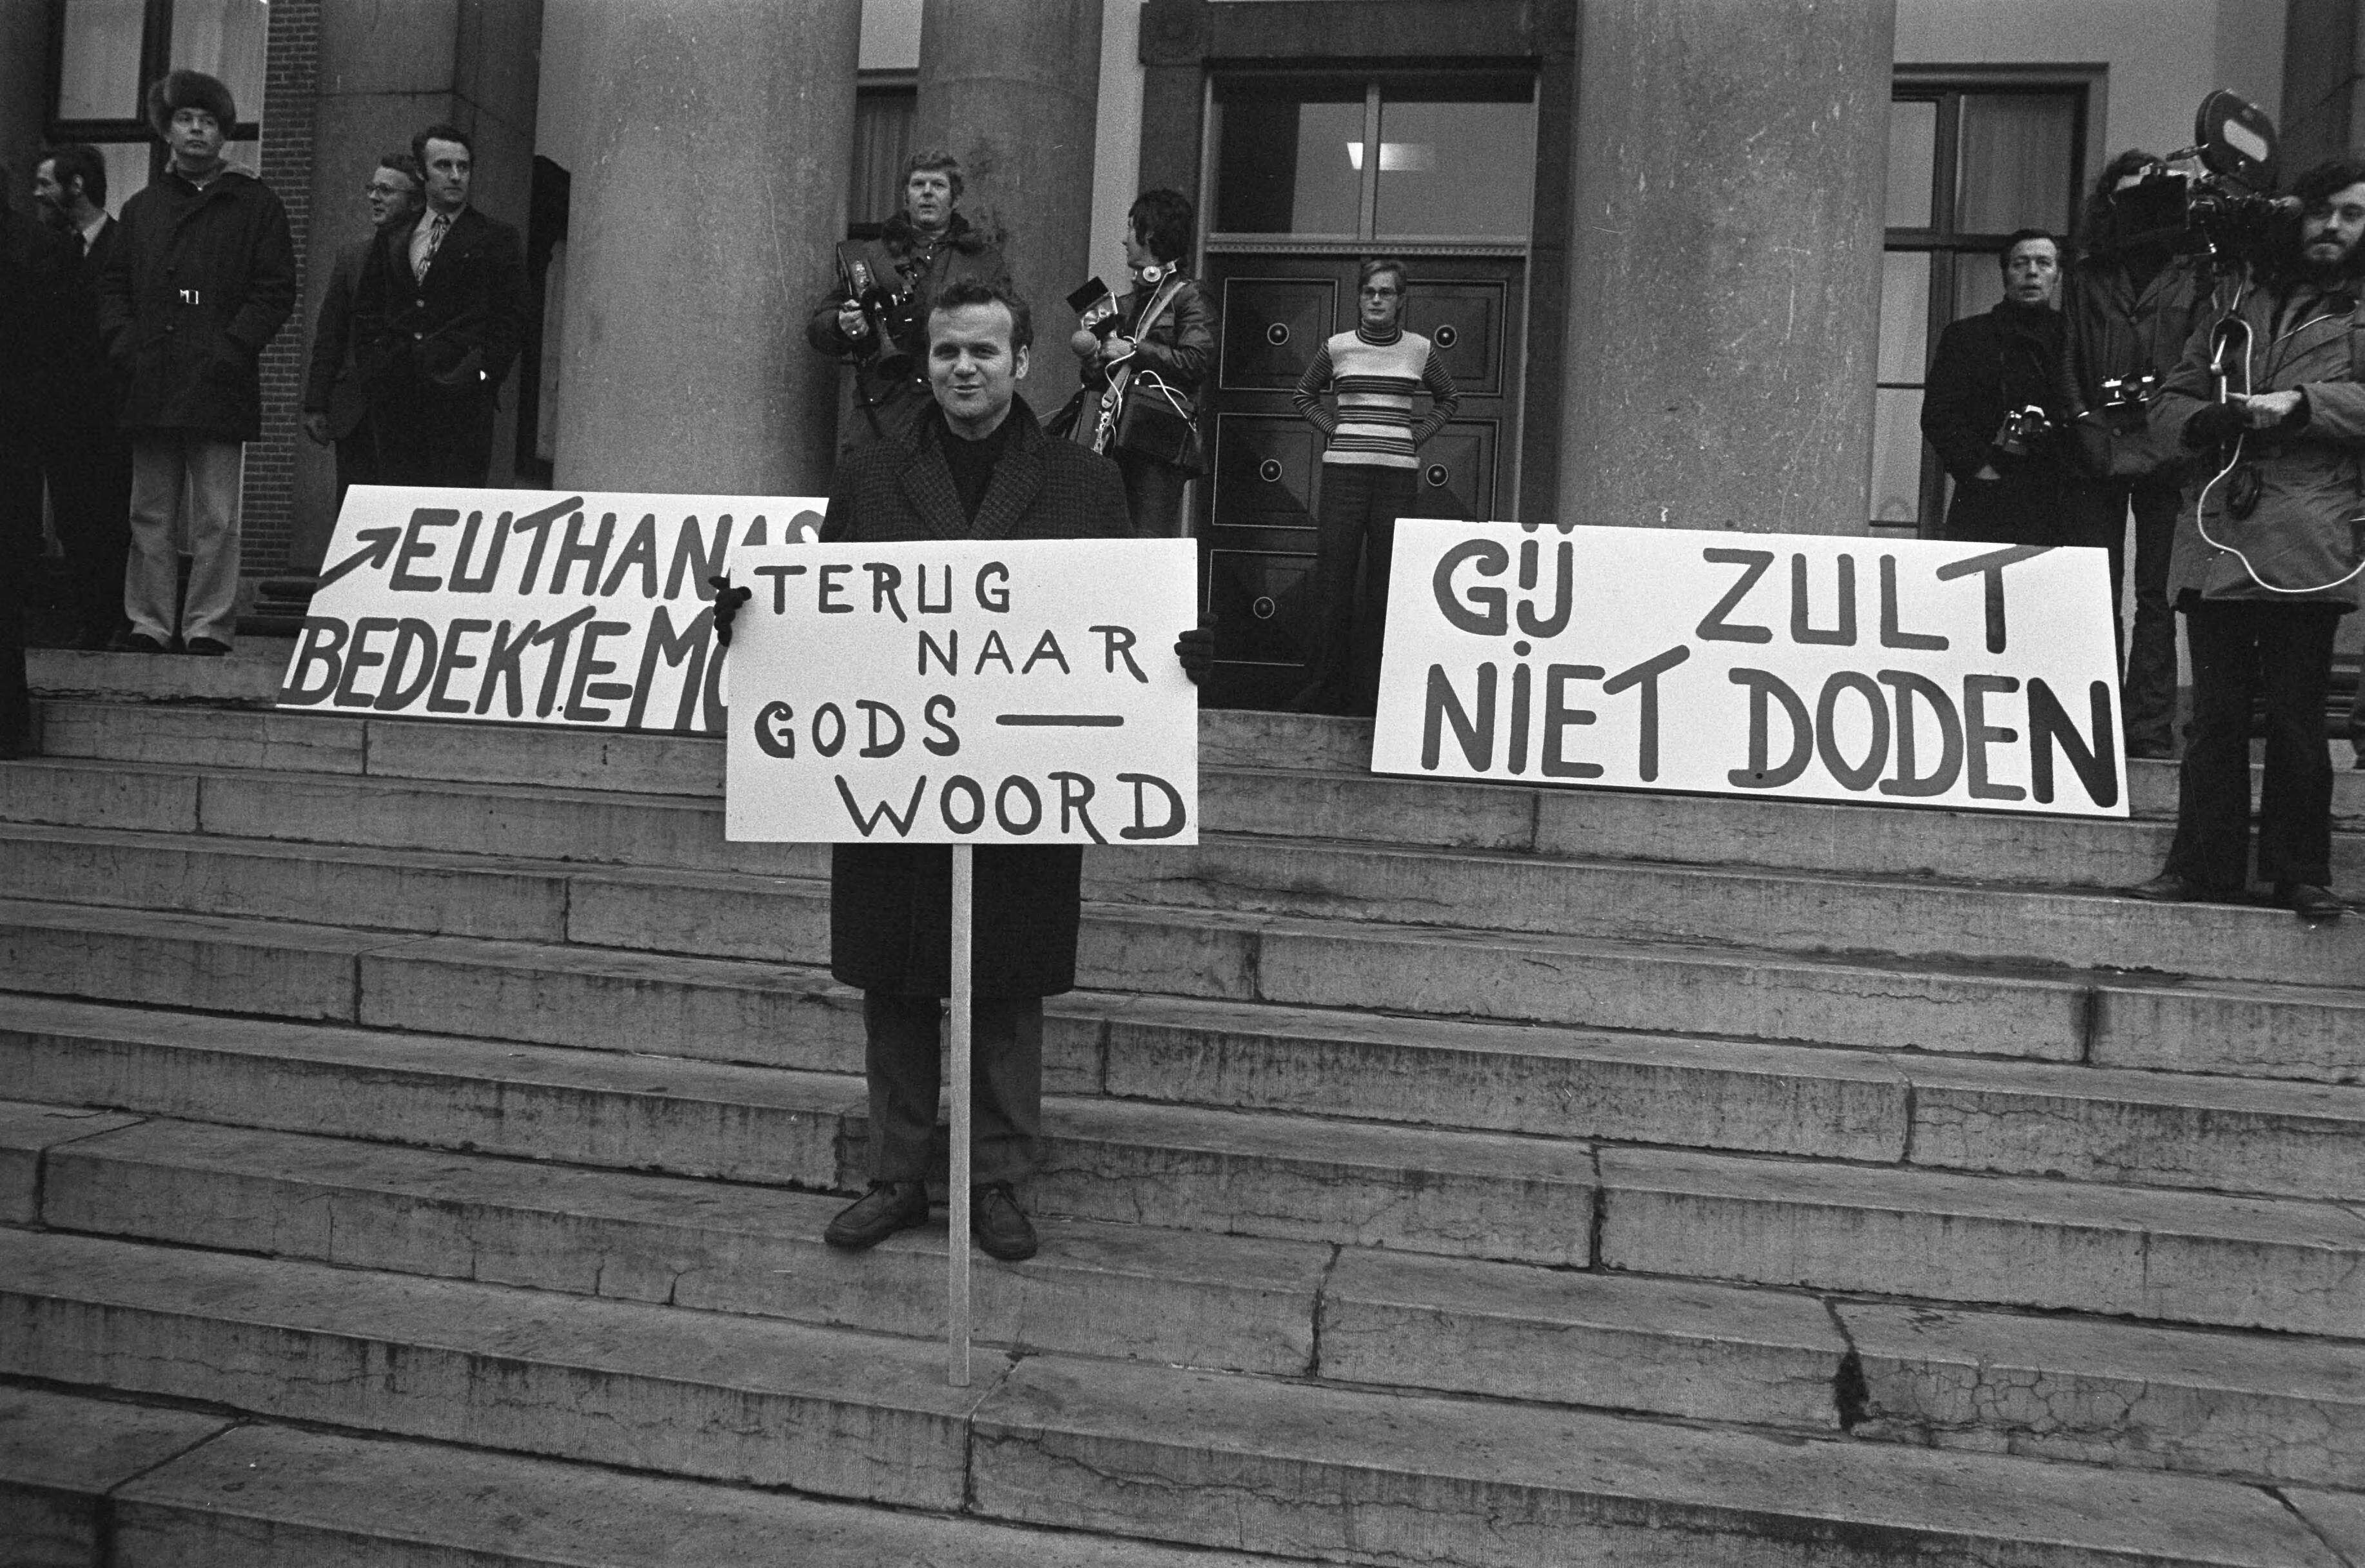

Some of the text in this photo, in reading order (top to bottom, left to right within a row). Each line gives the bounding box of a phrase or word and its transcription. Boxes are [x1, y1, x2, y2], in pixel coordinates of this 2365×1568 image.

[389, 496, 825, 601] EUTHAN
[754, 561, 1010, 622] TERUG
[1696, 545, 2056, 654] ZULT
[918, 625, 1149, 683] NAAR
[754, 694, 961, 759] GODS
[1729, 669, 2118, 808] DODEN
[835, 771, 1186, 844] WOORD
